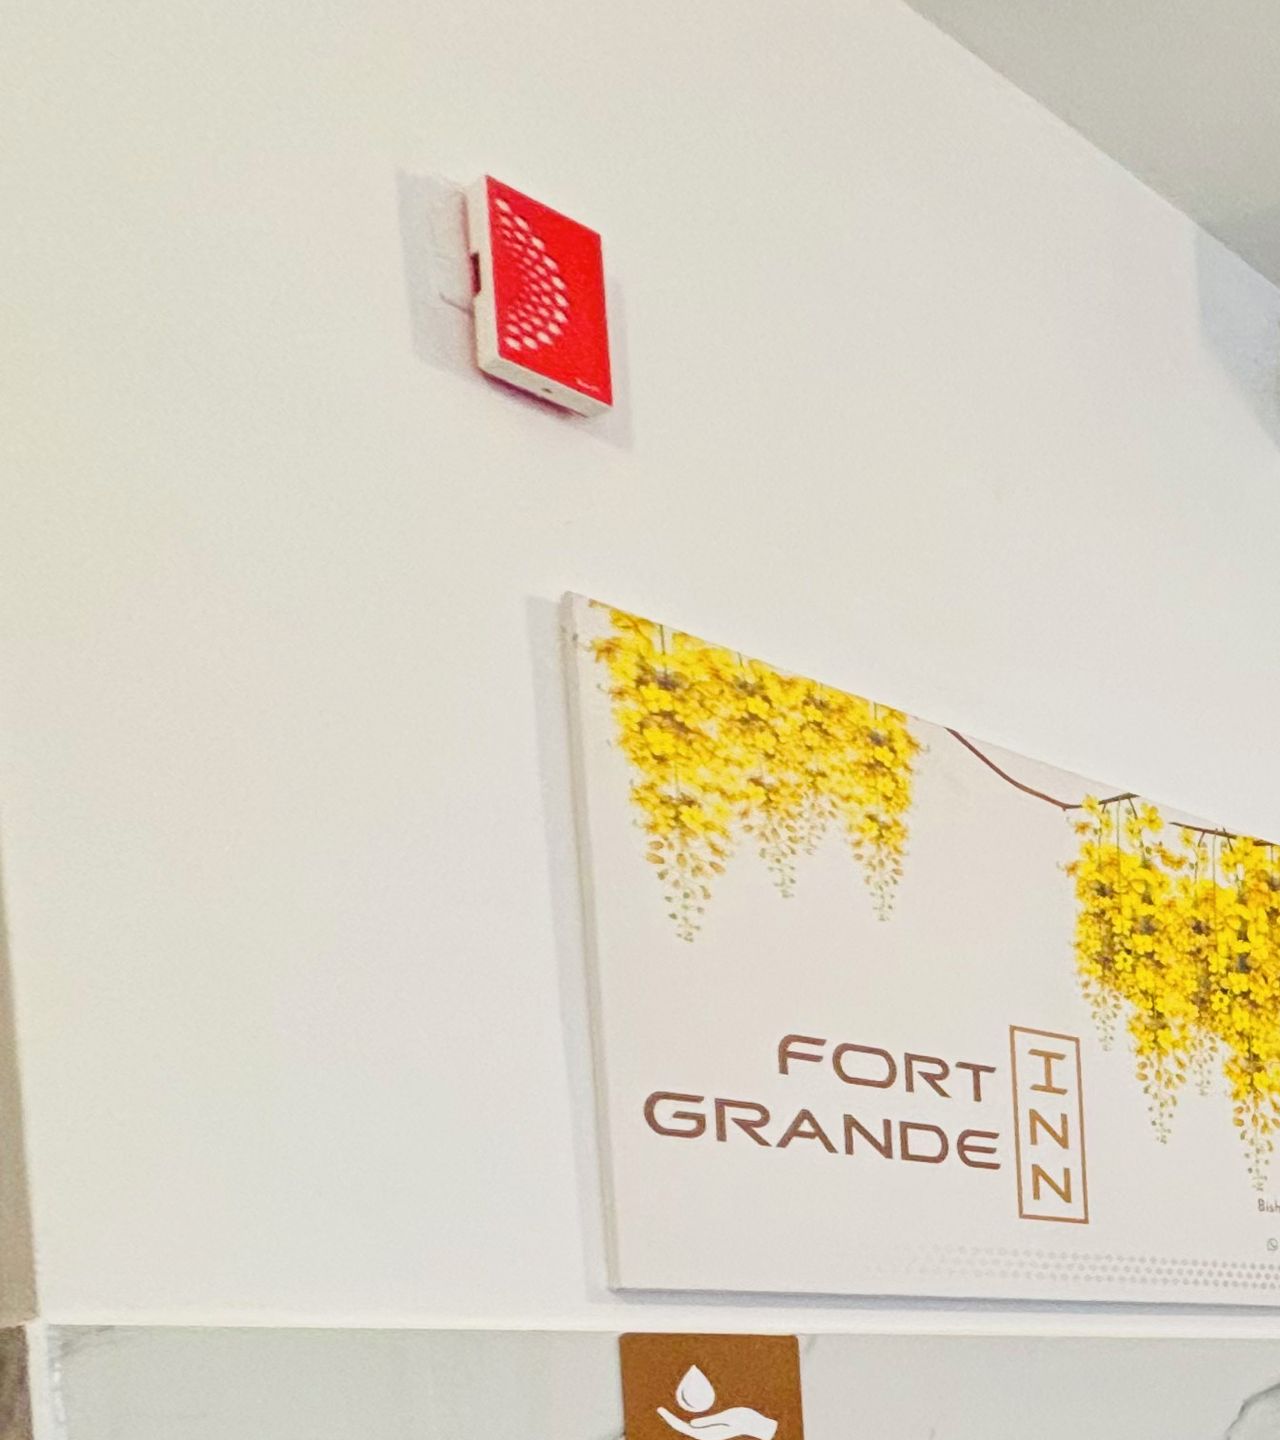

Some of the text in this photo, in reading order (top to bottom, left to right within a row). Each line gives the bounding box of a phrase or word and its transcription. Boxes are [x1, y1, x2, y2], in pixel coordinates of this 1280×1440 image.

[778, 1034, 997, 1102] FORT
[643, 1090, 1001, 1170] GRANDE
[1027, 1048, 1073, 1204] INN
